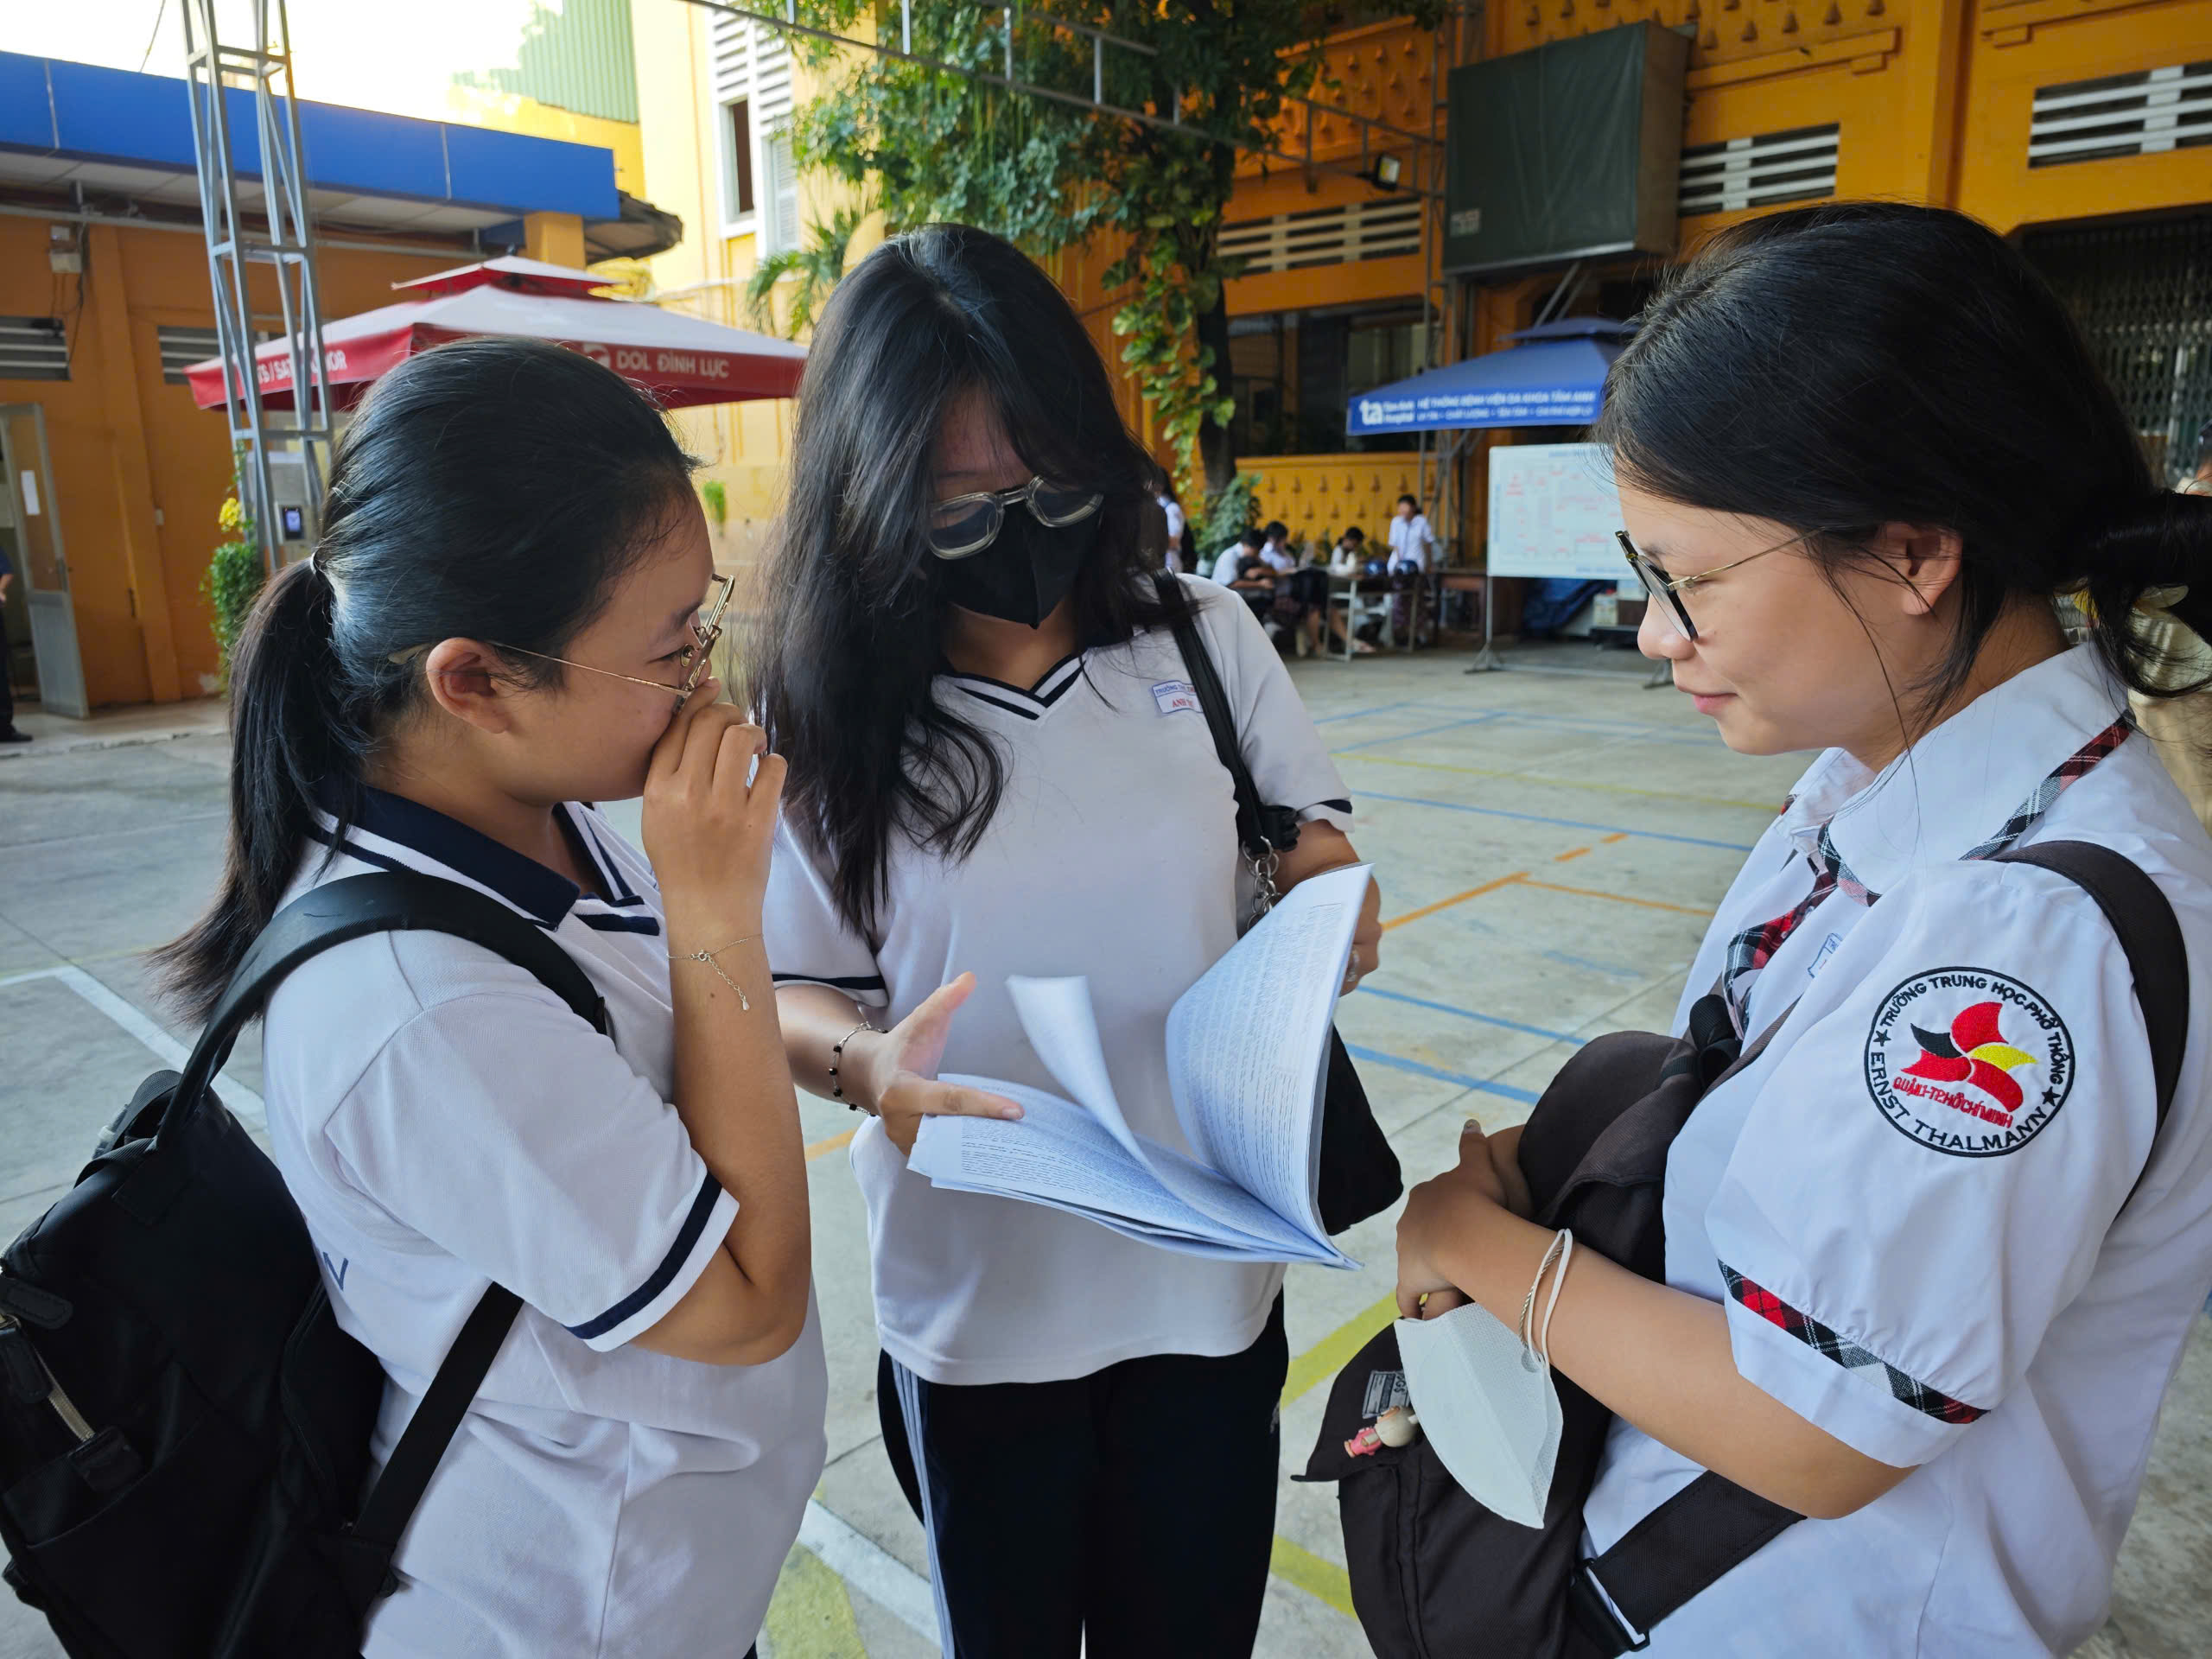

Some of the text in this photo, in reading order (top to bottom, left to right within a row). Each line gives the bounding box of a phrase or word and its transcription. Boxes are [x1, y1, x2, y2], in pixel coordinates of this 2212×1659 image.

[616, 350, 730, 380] DOL ĐÌNH LỤC
[1879, 982, 1928, 1027] TRƯỜNG
[1929, 974, 1988, 989] TRUNG
[1870, 1051, 2048, 1151] ERNST THALMANN
